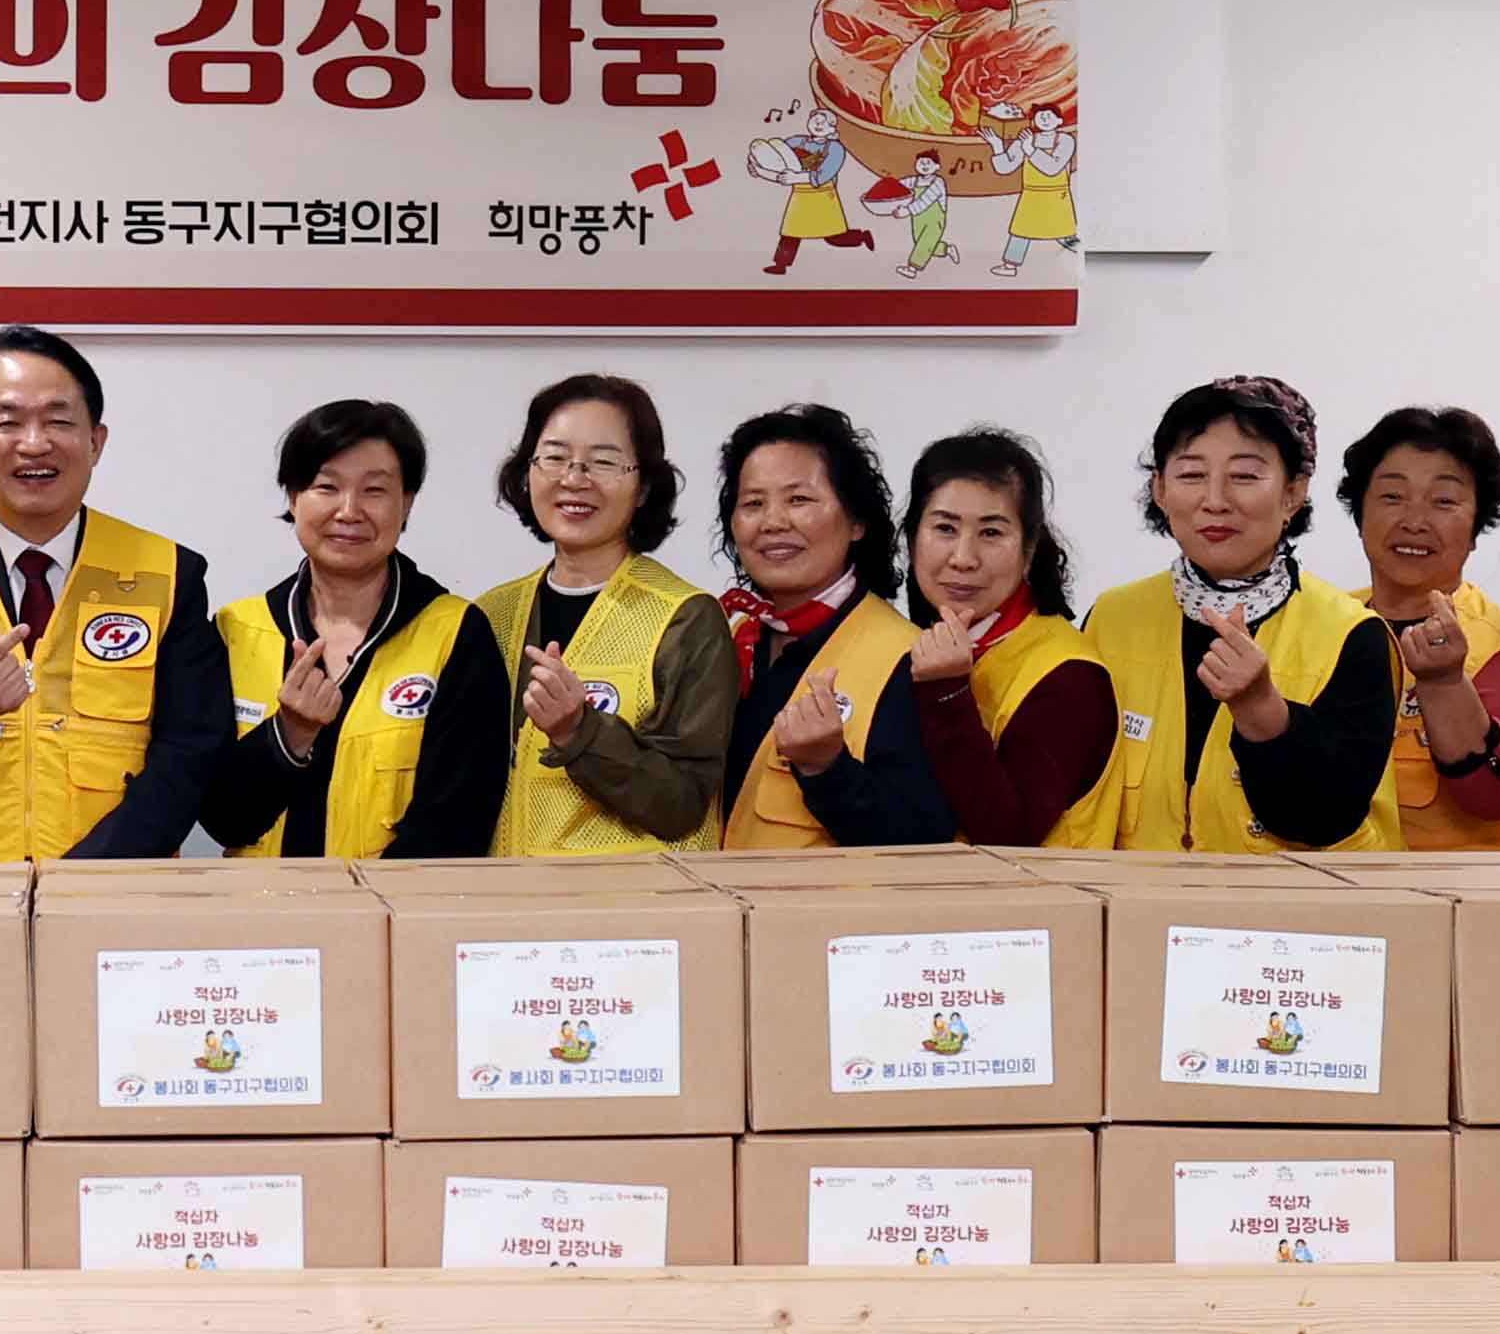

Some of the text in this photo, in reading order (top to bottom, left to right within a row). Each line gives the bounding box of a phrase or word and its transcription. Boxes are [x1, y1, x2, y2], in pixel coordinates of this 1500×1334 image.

[123, 198, 440, 246] 동구지구협의회
[487, 200, 654, 255] 희망풍차
[920, 967, 967, 985] 적십자
[193, 985, 239, 1002] 적십자
[882, 987, 1007, 1010] 사랑의 김장나눔
[154, 1006, 279, 1027] 사랑의 김장나눔
[881, 1056, 1036, 1080] 봉사회 동구지구협의회
[152, 1075, 309, 1097] 봉사회 동구지구협의회
[1266, 1193, 1312, 1211] 적십자
[539, 1216, 586, 1233] 적십자
[1228, 1215, 1352, 1235] 사랑의 김장나눔
[499, 1237, 625, 1259] 사랑의 김장나눔
